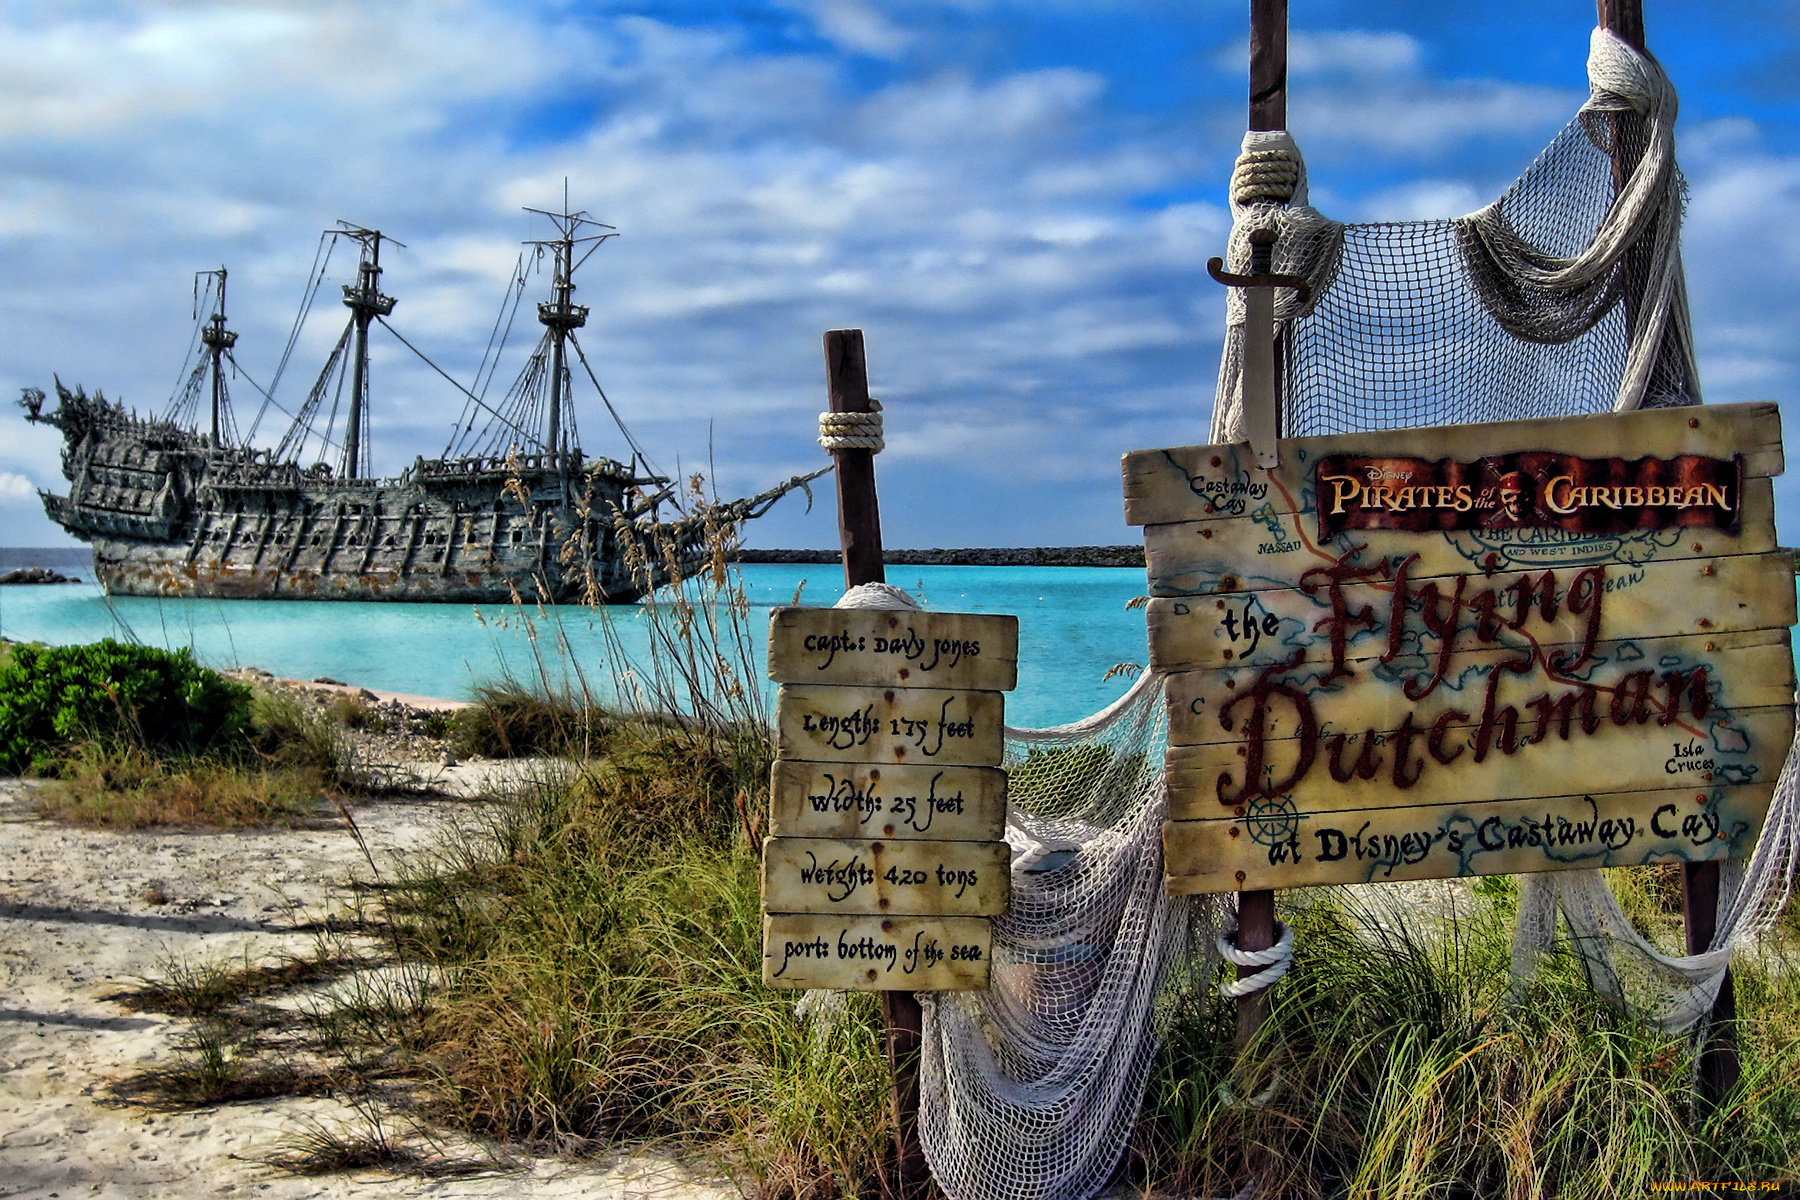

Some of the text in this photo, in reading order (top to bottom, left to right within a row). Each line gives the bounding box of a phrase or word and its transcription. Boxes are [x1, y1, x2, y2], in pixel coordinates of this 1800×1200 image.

[1189, 470, 1269, 500] Castaway
[1322, 475, 1473, 514] PIRATES
[1544, 475, 1732, 514] CARIBBEAN
[1211, 493, 1247, 515] Cay
[1257, 541, 1301, 555] NASSAU
[1507, 541, 1613, 556] AND WEST INDIES
[1220, 543, 1606, 700] the Flying
[890, 717, 926, 747] 175
[922, 696, 975, 756] feet
[1216, 647, 1712, 806] Dutchman
[1664, 757, 1715, 775] Cruces
[1674, 738, 1705, 758] Isla
[889, 797, 917, 824] 25
[913, 772, 965, 832] feet
[1268, 795, 1720, 878] at Disney's Castaway Cay
[883, 867, 927, 886] 420
[936, 866, 978, 899] tons
[773, 935, 829, 977] port:
[837, 929, 897, 973] bottom
[903, 931, 925, 975] of
[950, 944, 982, 962] sea
